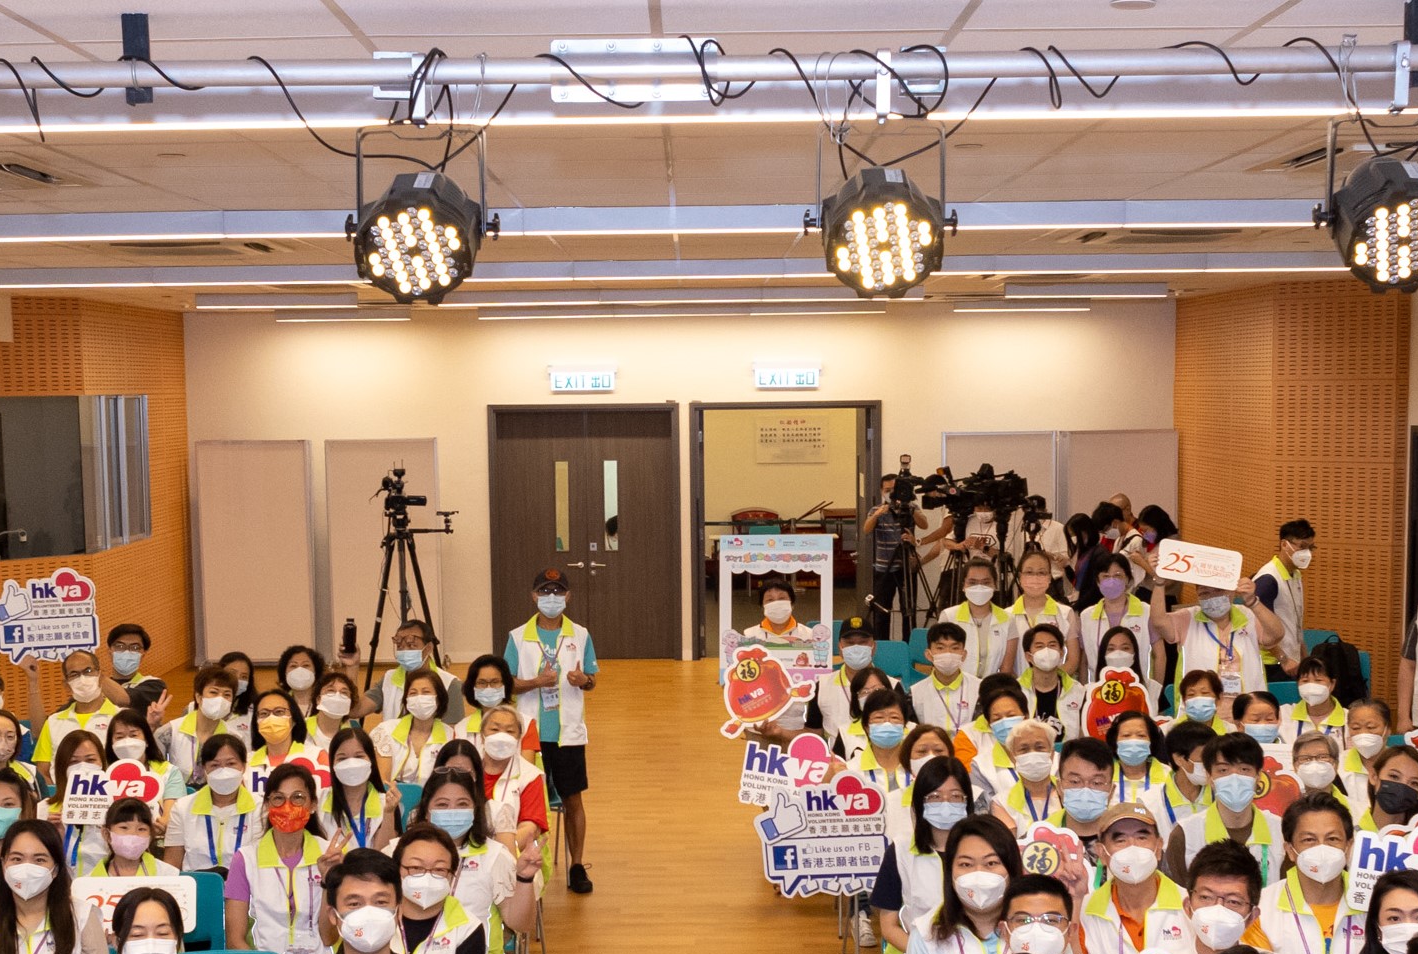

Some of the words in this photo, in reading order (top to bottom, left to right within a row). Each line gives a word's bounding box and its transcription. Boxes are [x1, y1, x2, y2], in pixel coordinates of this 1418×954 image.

[554, 375, 585, 388] EXIT
[591, 375, 611, 388] 出口
[759, 372, 789, 385] EXIT
[795, 373, 815, 385] 出口
[1161, 552, 1195, 573] 25
[32, 583, 81, 598] hkva
[739, 662, 757, 681] 福
[745, 743, 830, 782] hkva
[71, 774, 145, 798] hkva
[744, 773, 765, 781] HONG
[767, 777, 788, 786] KONG
[806, 790, 869, 811] hkva
[808, 824, 882, 834] 香港志願者協會
[815, 845, 832, 853] Like
[859, 843, 870, 851] FB
[802, 855, 881, 869] 香港志願者協會
[1024, 843, 1056, 874] 福
